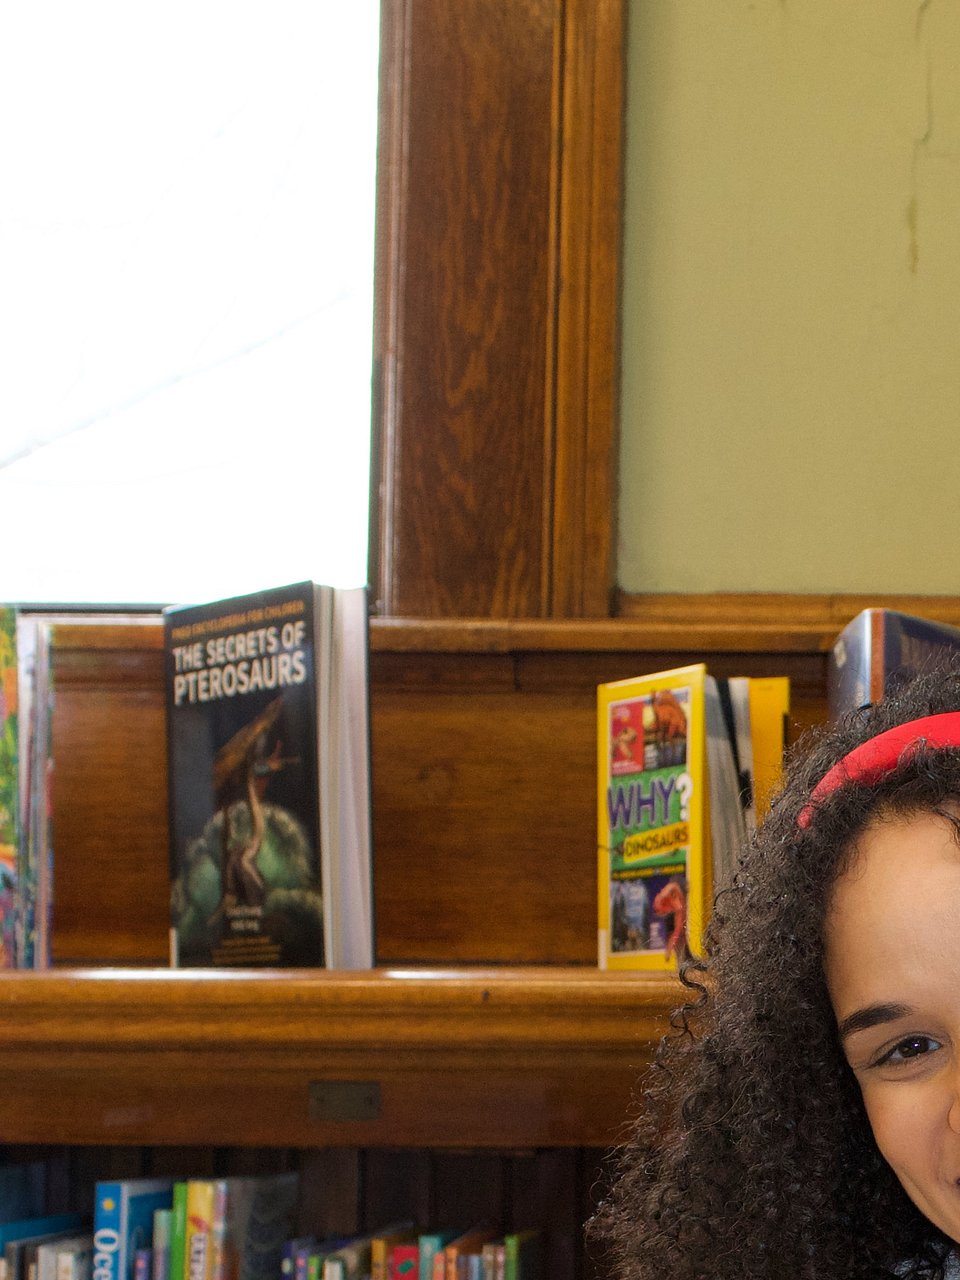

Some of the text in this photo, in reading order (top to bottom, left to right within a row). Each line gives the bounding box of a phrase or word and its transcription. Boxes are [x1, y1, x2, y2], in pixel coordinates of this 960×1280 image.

[173, 642, 204, 672] THE
[206, 626, 279, 666] SECRETS
[281, 620, 305, 650] OF
[174, 650, 306, 706] PTEROSAURS
[624, 825, 690, 858] DINOSAURS
